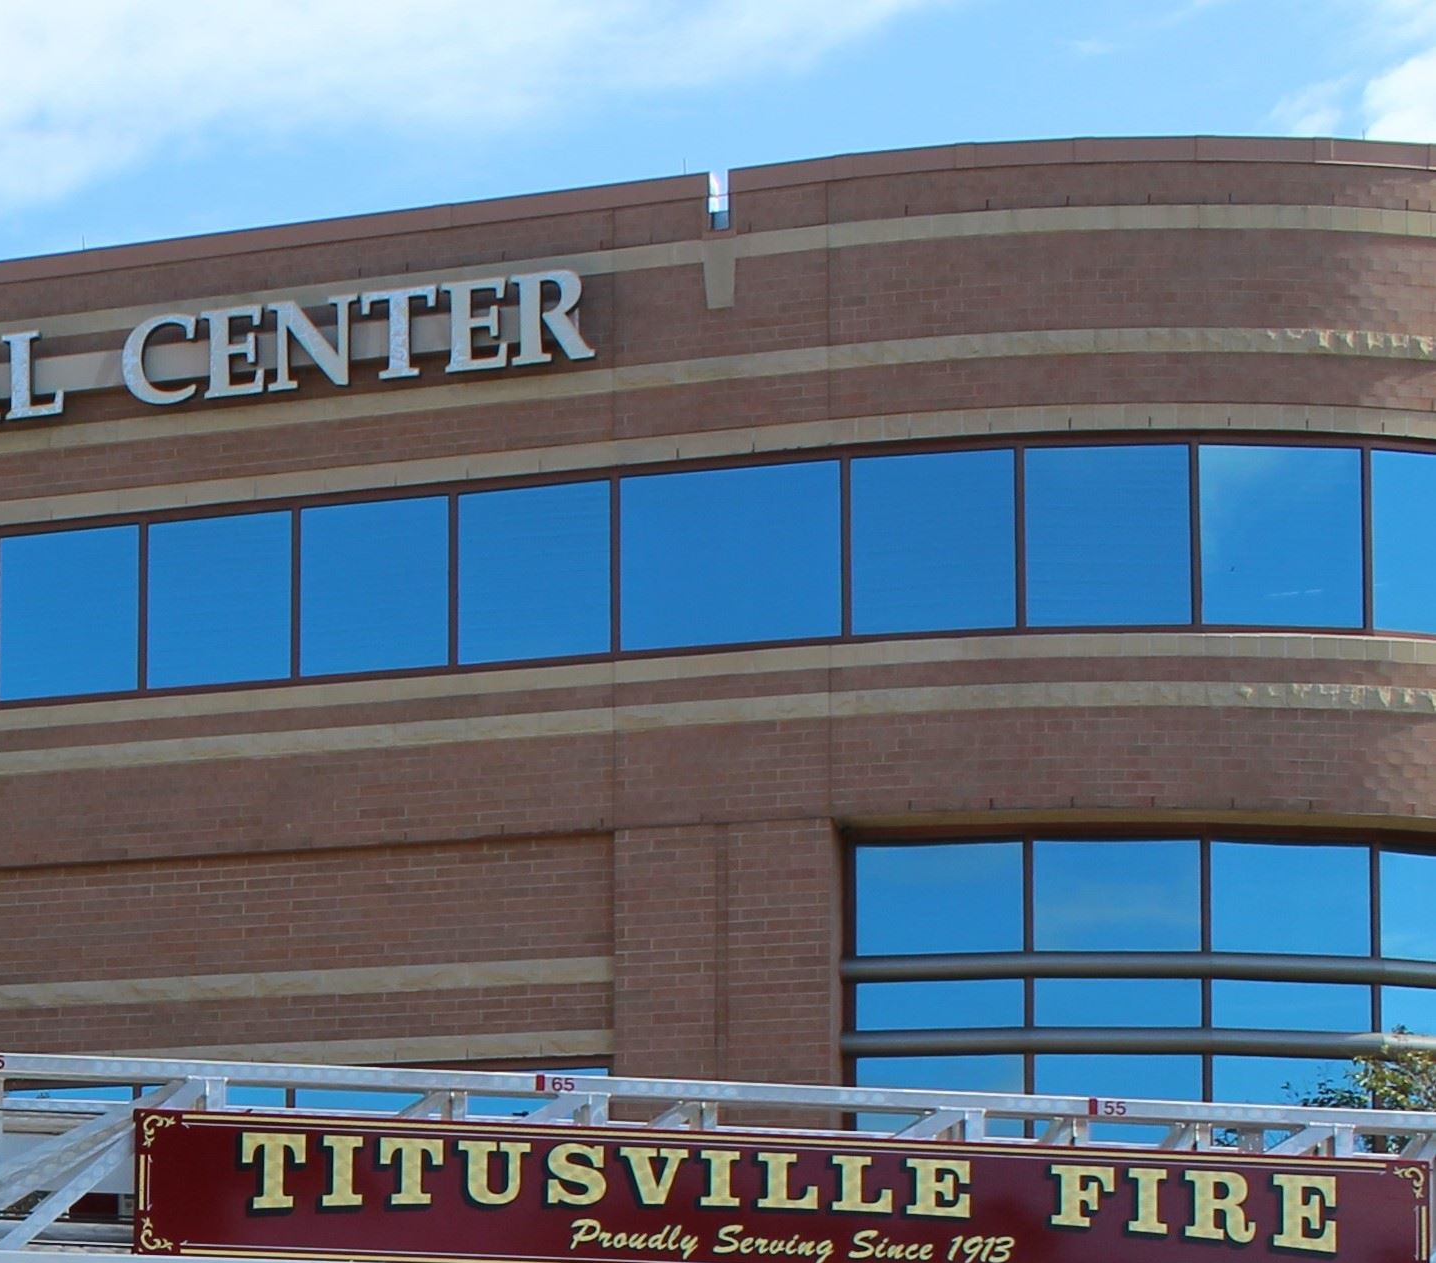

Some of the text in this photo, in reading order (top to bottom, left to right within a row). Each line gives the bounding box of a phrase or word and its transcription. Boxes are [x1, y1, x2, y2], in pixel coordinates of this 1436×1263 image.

[122, 269, 597, 406] CENTER
[551, 1076, 575, 1092] 65
[1103, 1100, 1127, 1116] 55
[239, 1131, 1338, 1254] TITUSVILLE FIRE
[569, 1218, 699, 1260] Proudly
[847, 1229, 934, 1262] Since
